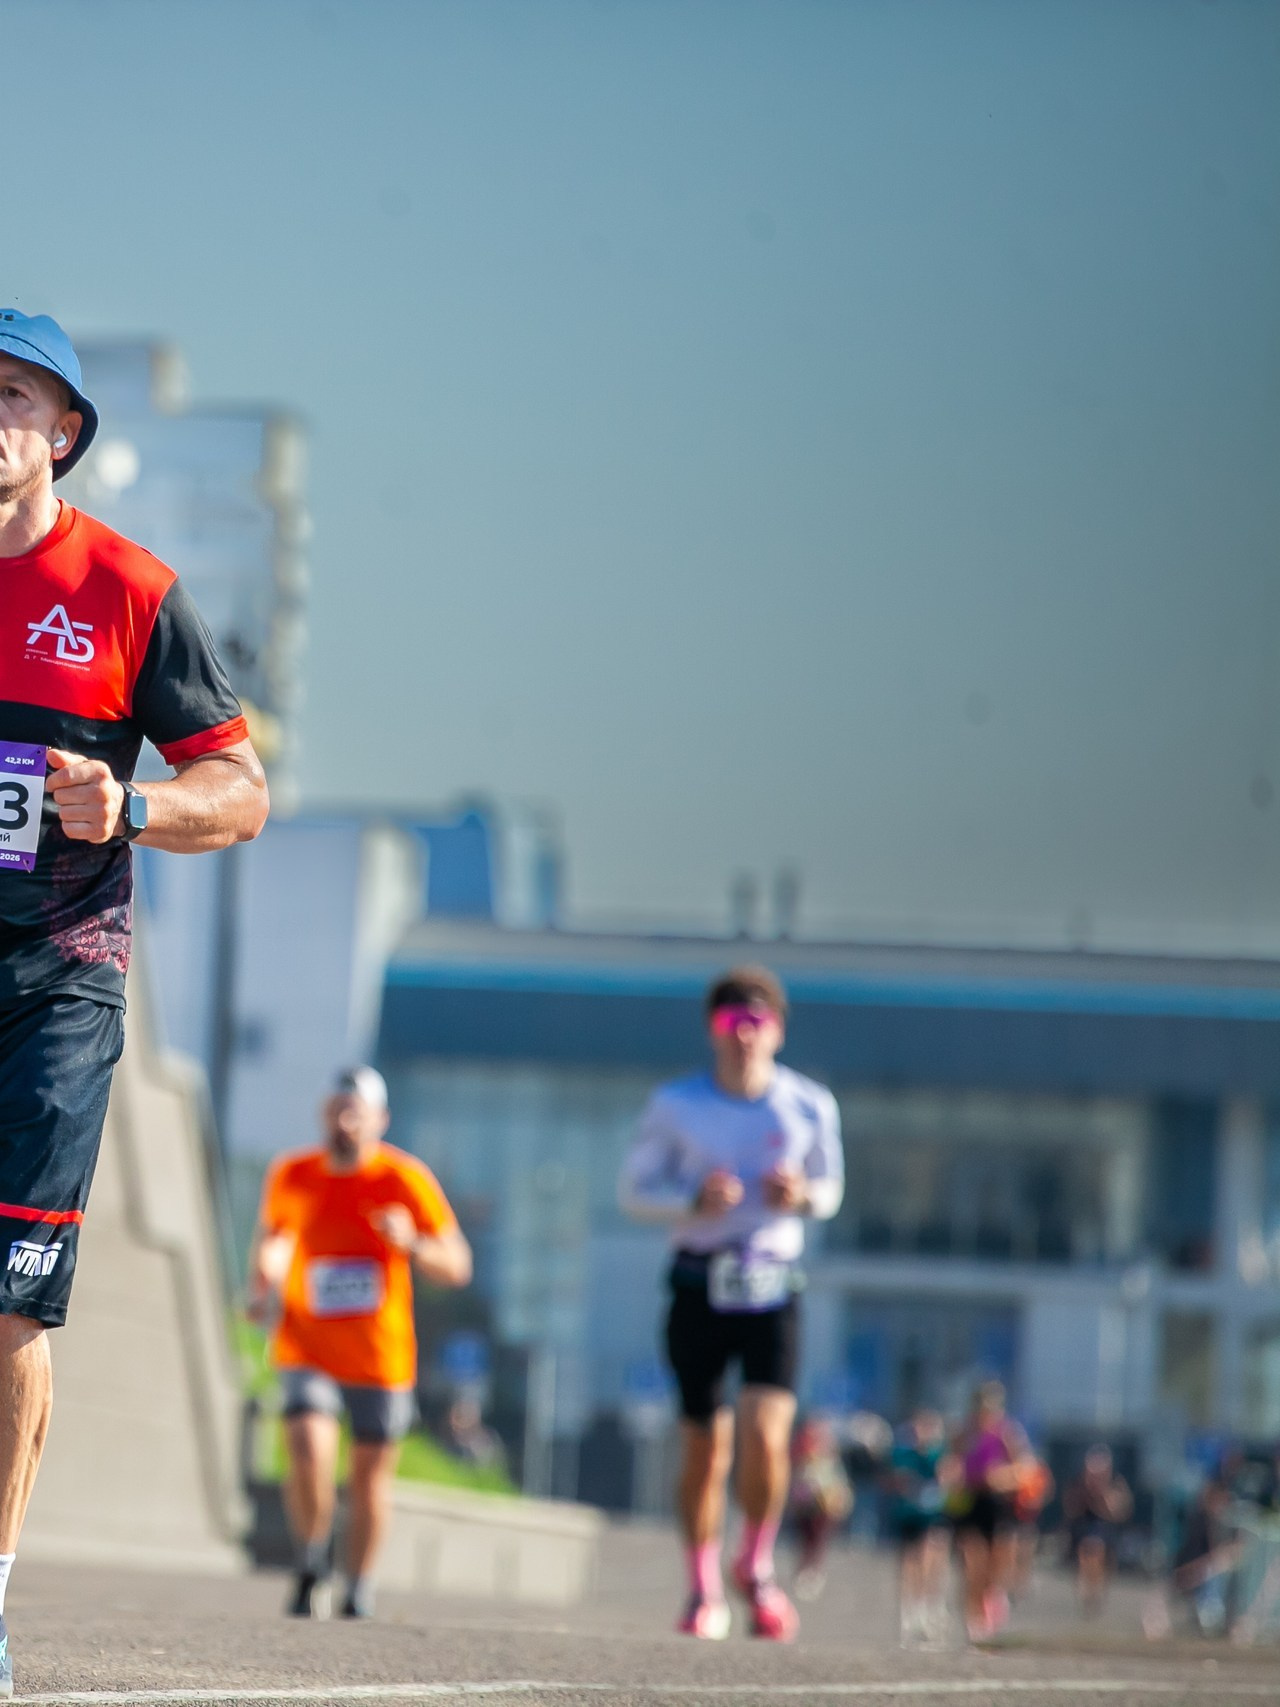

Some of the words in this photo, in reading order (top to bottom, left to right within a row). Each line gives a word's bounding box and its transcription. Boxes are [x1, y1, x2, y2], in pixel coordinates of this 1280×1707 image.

[4, 756, 21, 765] 42,2
[22, 758, 35, 766] КМ
[0, 852, 21, 862] 2026
